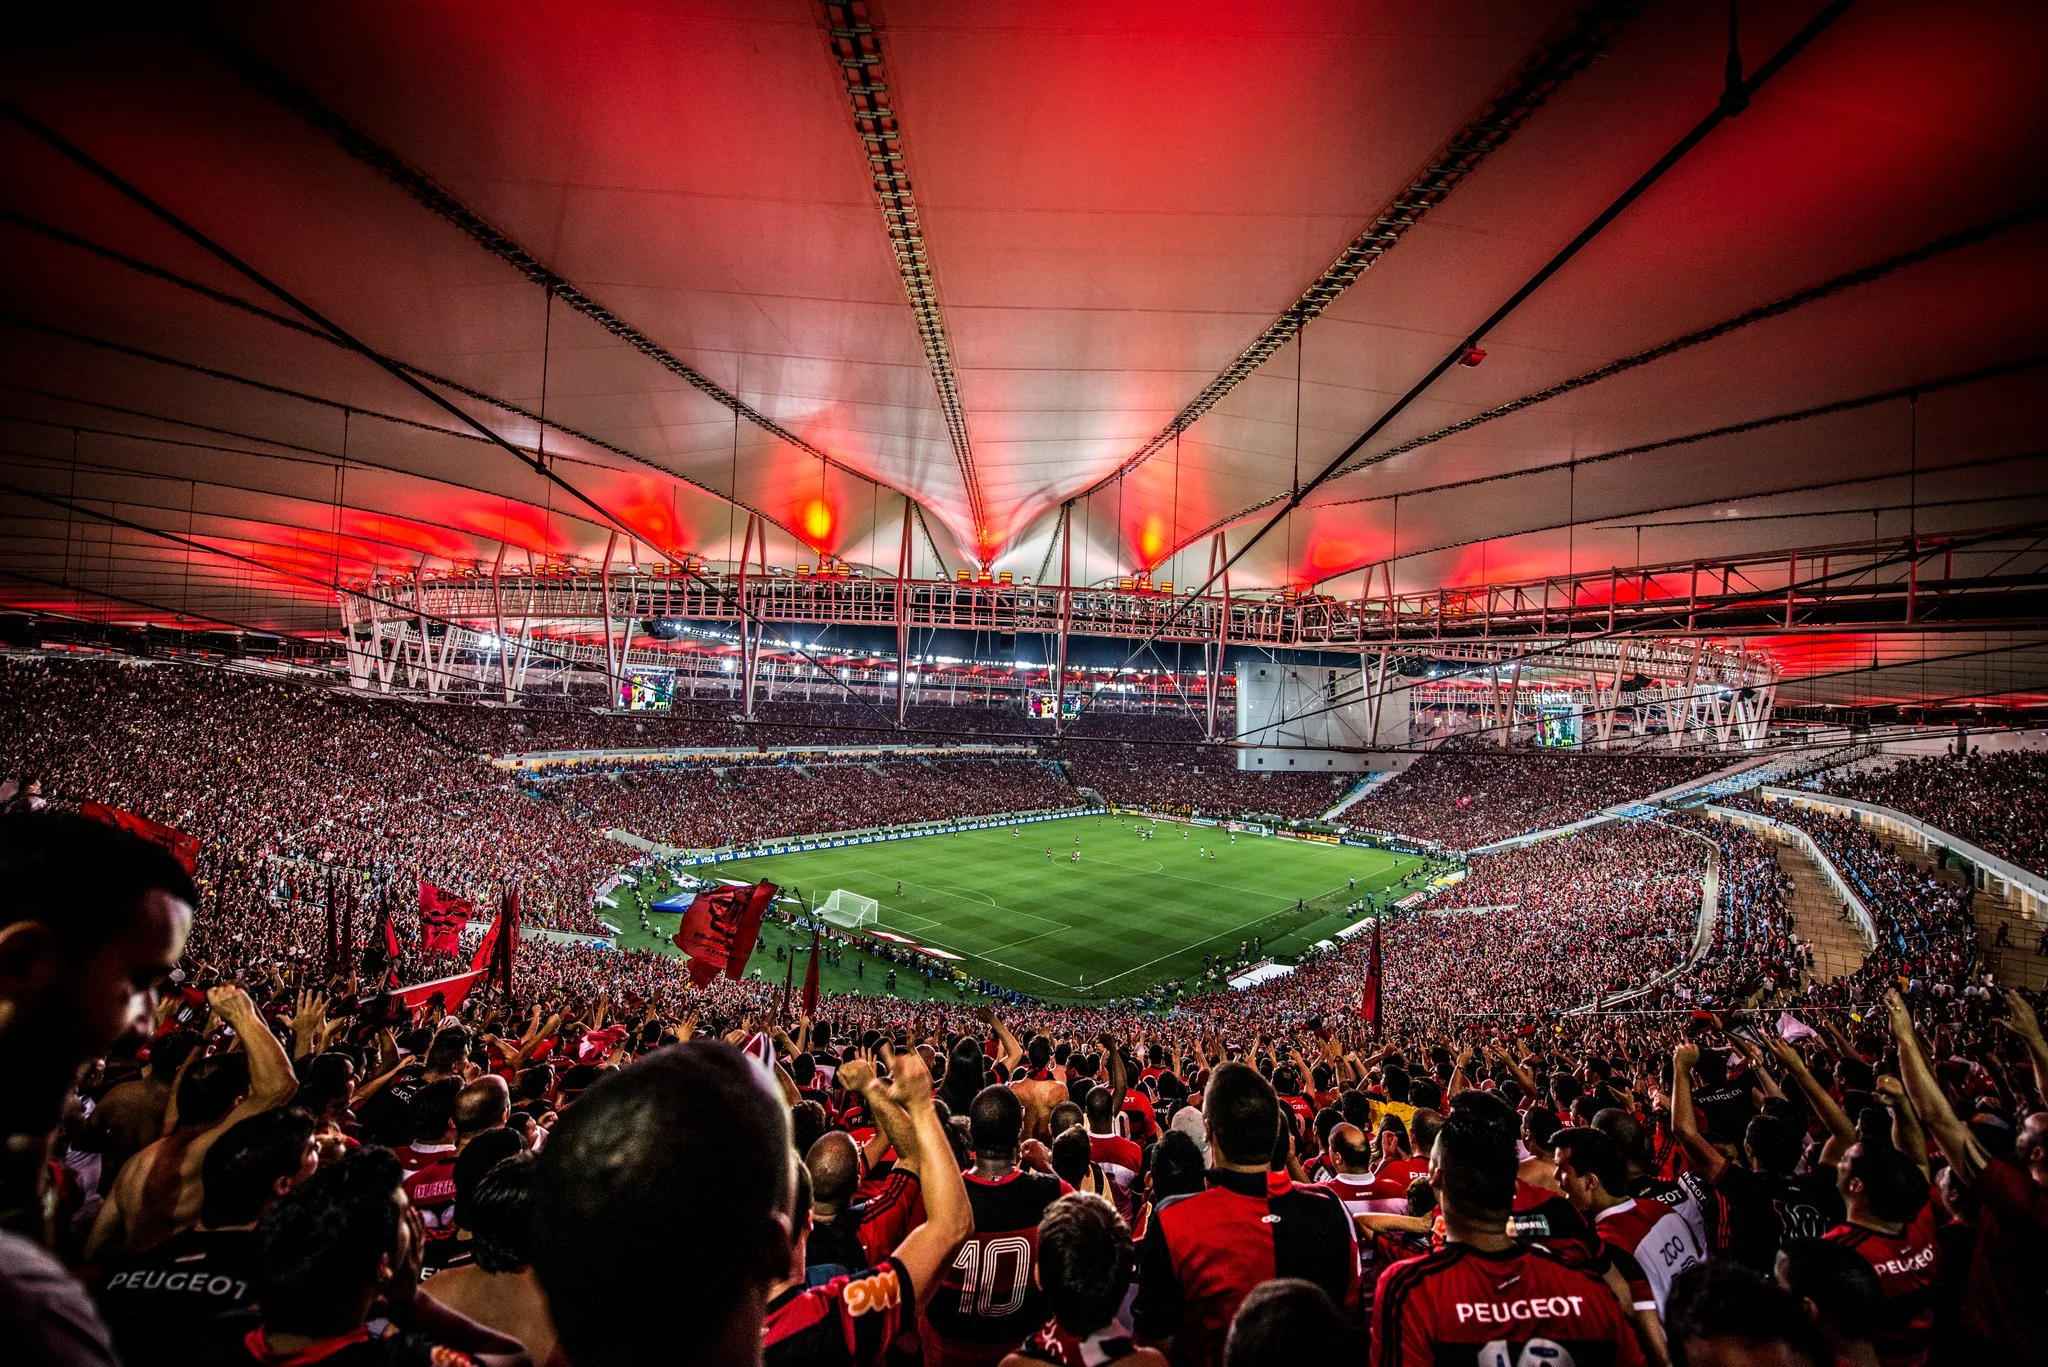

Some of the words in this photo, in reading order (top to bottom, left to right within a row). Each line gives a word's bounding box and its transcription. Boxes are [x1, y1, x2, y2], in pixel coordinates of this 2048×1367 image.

[737, 851, 750, 859] VISA
[754, 849, 768, 857] VISA
[771, 847, 784, 855] VISA
[680, 858, 696, 866] VISA
[700, 856, 715, 864] VISA
[719, 854, 733, 862] VISA
[796, 916, 809, 928] VISA
[813, 922, 826, 934] VISA
[1874, 1244, 1934, 1277] PEUGEO
[952, 1237, 1030, 1317] 10
[1456, 1296, 1583, 1323] PEUGEOT
